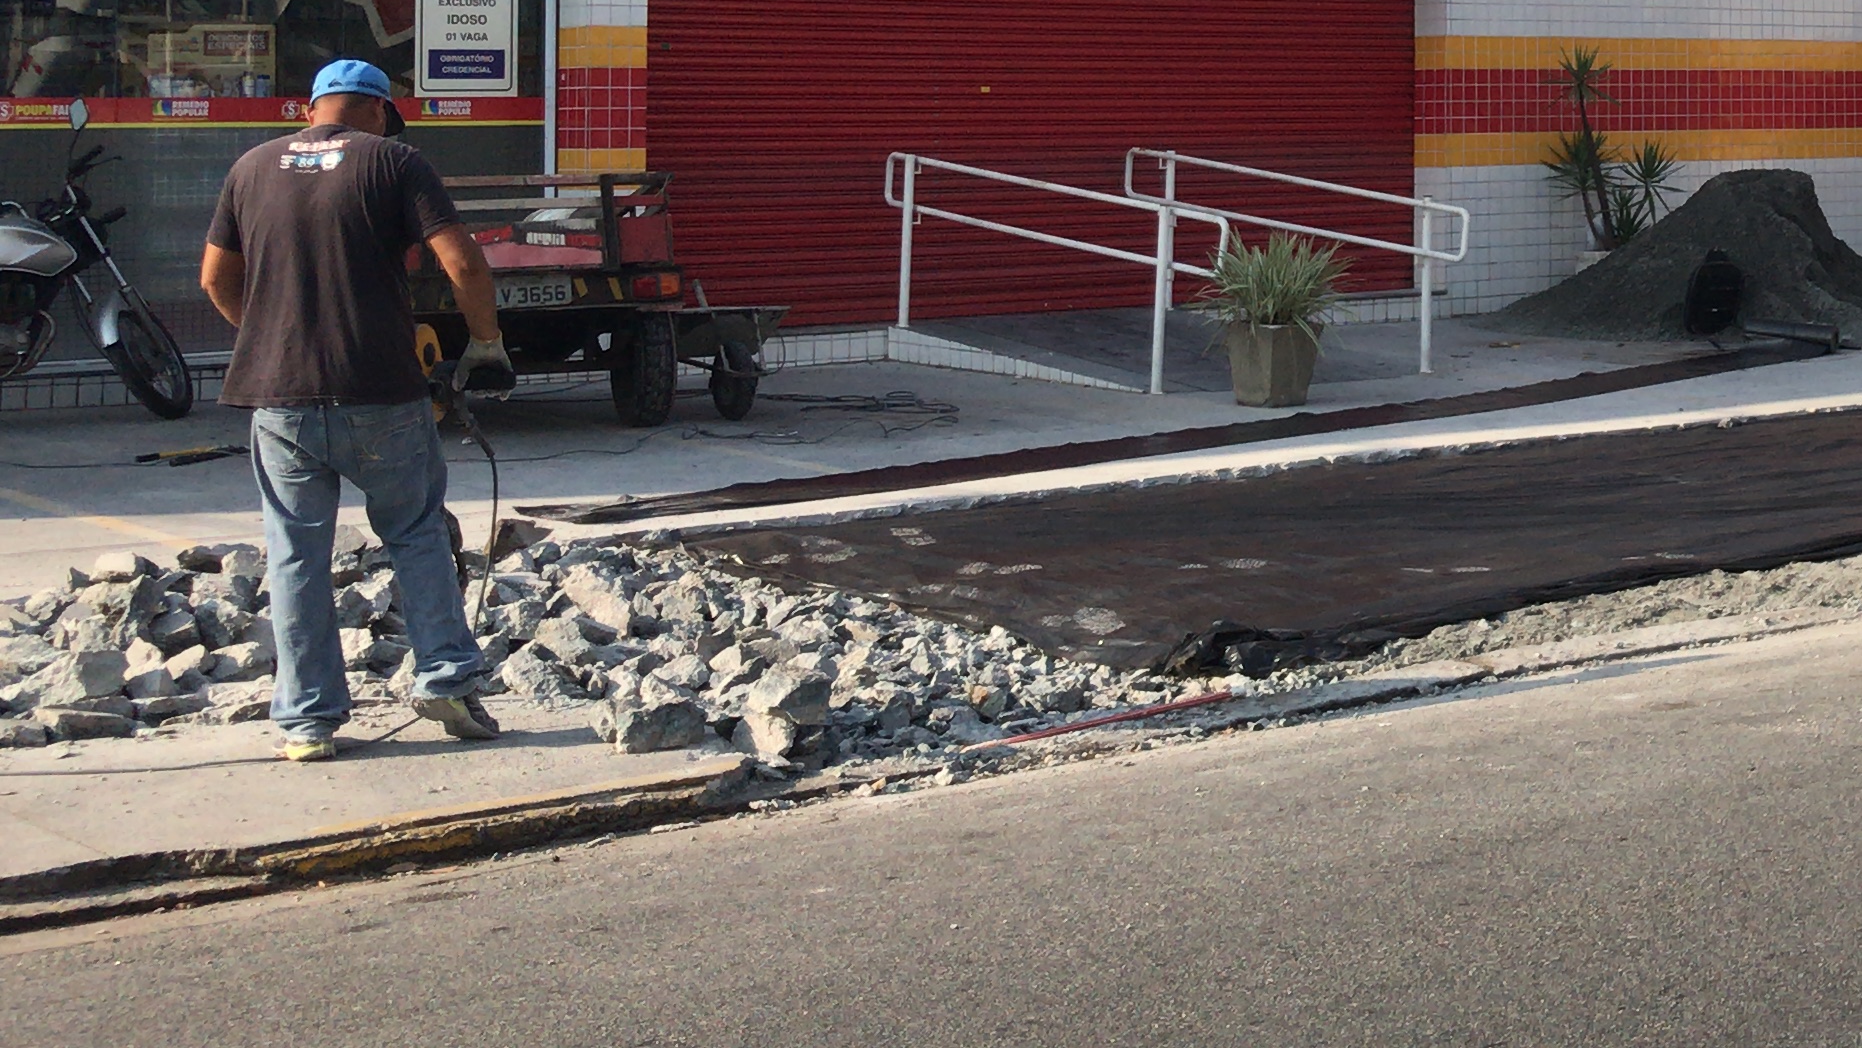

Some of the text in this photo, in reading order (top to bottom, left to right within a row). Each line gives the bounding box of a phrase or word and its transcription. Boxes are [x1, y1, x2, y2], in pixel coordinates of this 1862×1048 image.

[446, 14, 488, 26] IDOSO
[445, 32, 489, 42] 01 VAGA
[439, 53, 495, 63] OBRIGATÓRIO
[441, 65, 493, 75] CREDENCIAL
